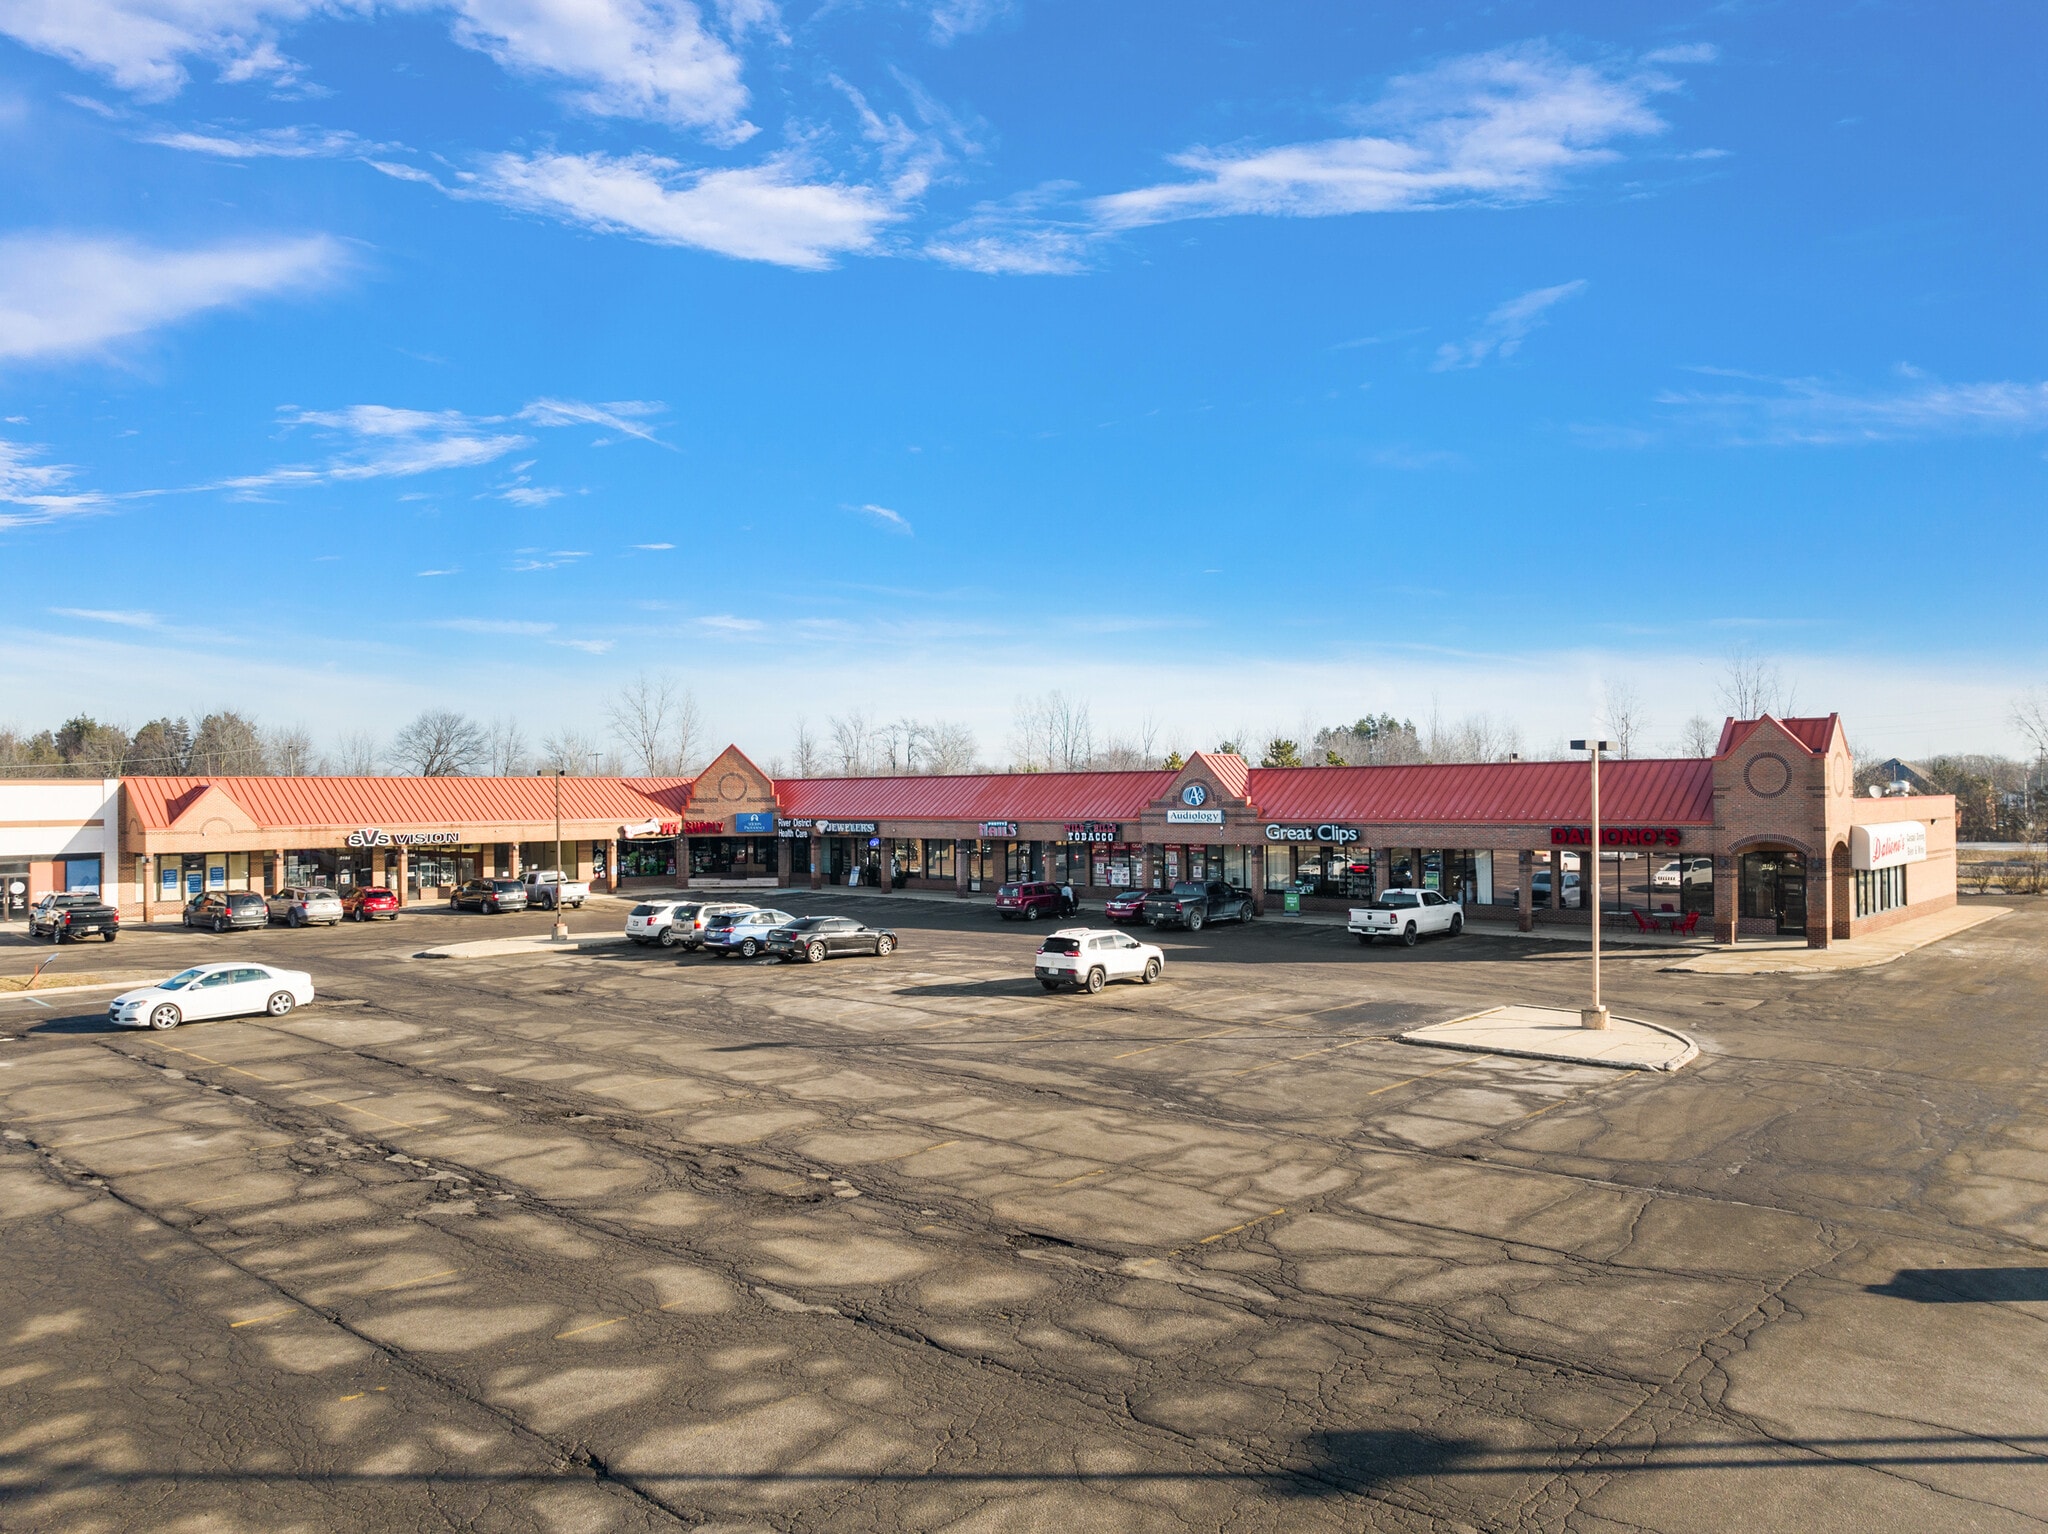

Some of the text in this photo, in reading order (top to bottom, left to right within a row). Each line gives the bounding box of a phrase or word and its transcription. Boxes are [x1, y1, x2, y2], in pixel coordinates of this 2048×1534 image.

[1170, 812, 1219, 822] Audiology
[778, 818, 812, 827] River District
[1063, 823, 1084, 832] WILD
[662, 821, 681, 835] PET
[684, 821, 725, 834] SUPPLY
[978, 823, 1017, 837] NAILS
[396, 832, 460, 844] VISION
[778, 829, 808, 838] Health Care
[1068, 832, 1113, 841] TOBACCO
[1265, 824, 1358, 845] Great Clips
